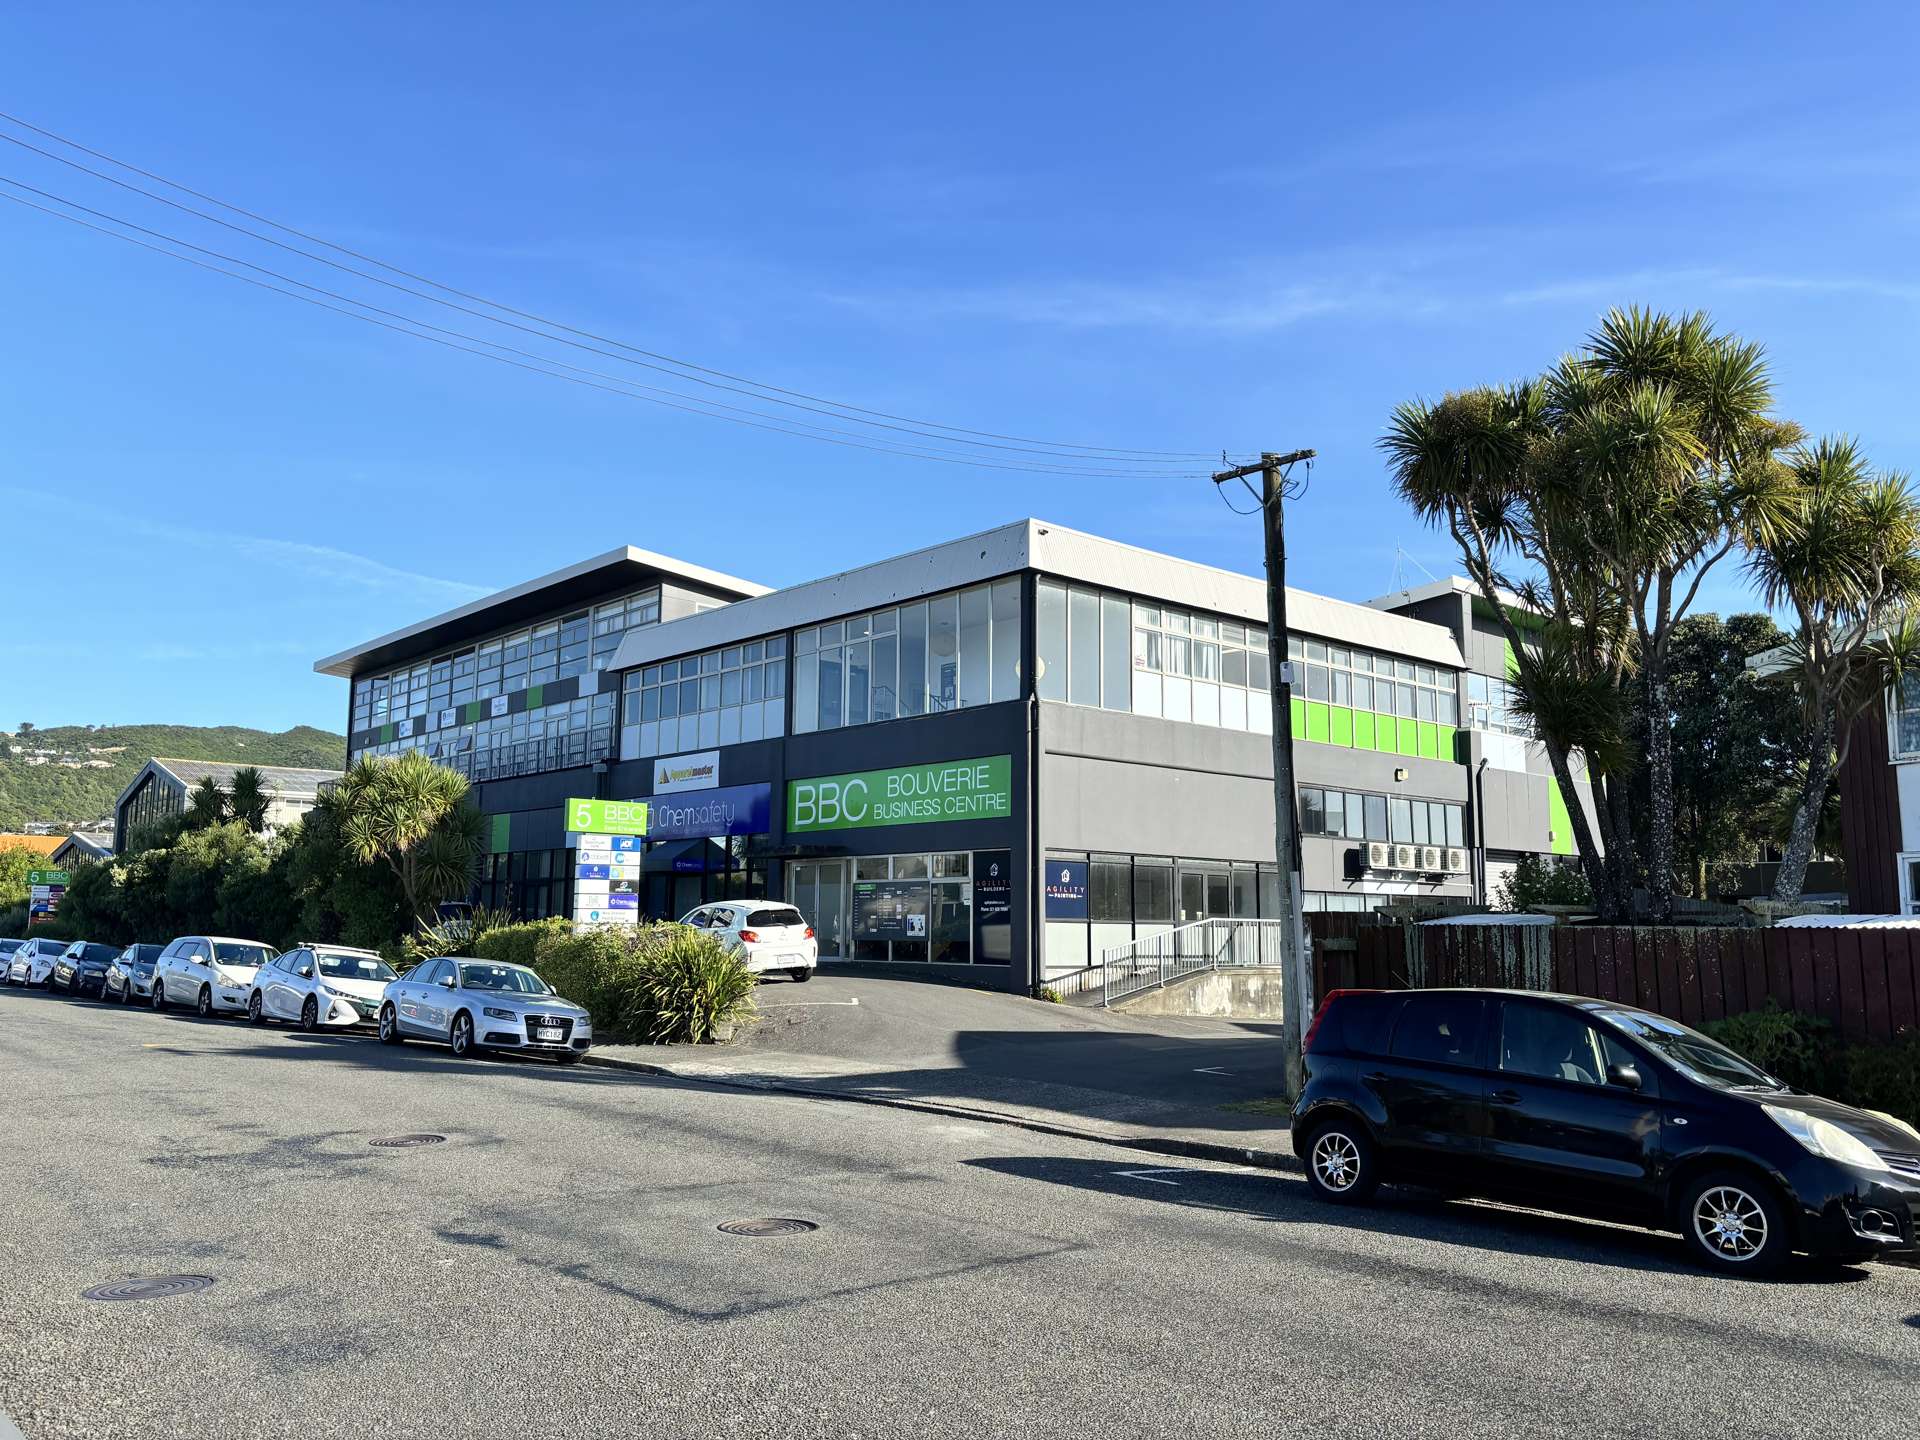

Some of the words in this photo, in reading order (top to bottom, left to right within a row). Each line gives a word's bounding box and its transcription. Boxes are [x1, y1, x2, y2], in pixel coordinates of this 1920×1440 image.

[887, 765, 990, 797] BOUVERIE
[575, 803, 592, 828] 5
[604, 804, 644, 821] BBC
[658, 799, 735, 828] Chemsafety
[795, 779, 868, 825] BBC
[873, 797, 941, 820] BUSINESS
[944, 792, 1006, 813] CENTRE
[31, 871, 39, 882] 5
[1046, 885, 1085, 894] AGILITY
